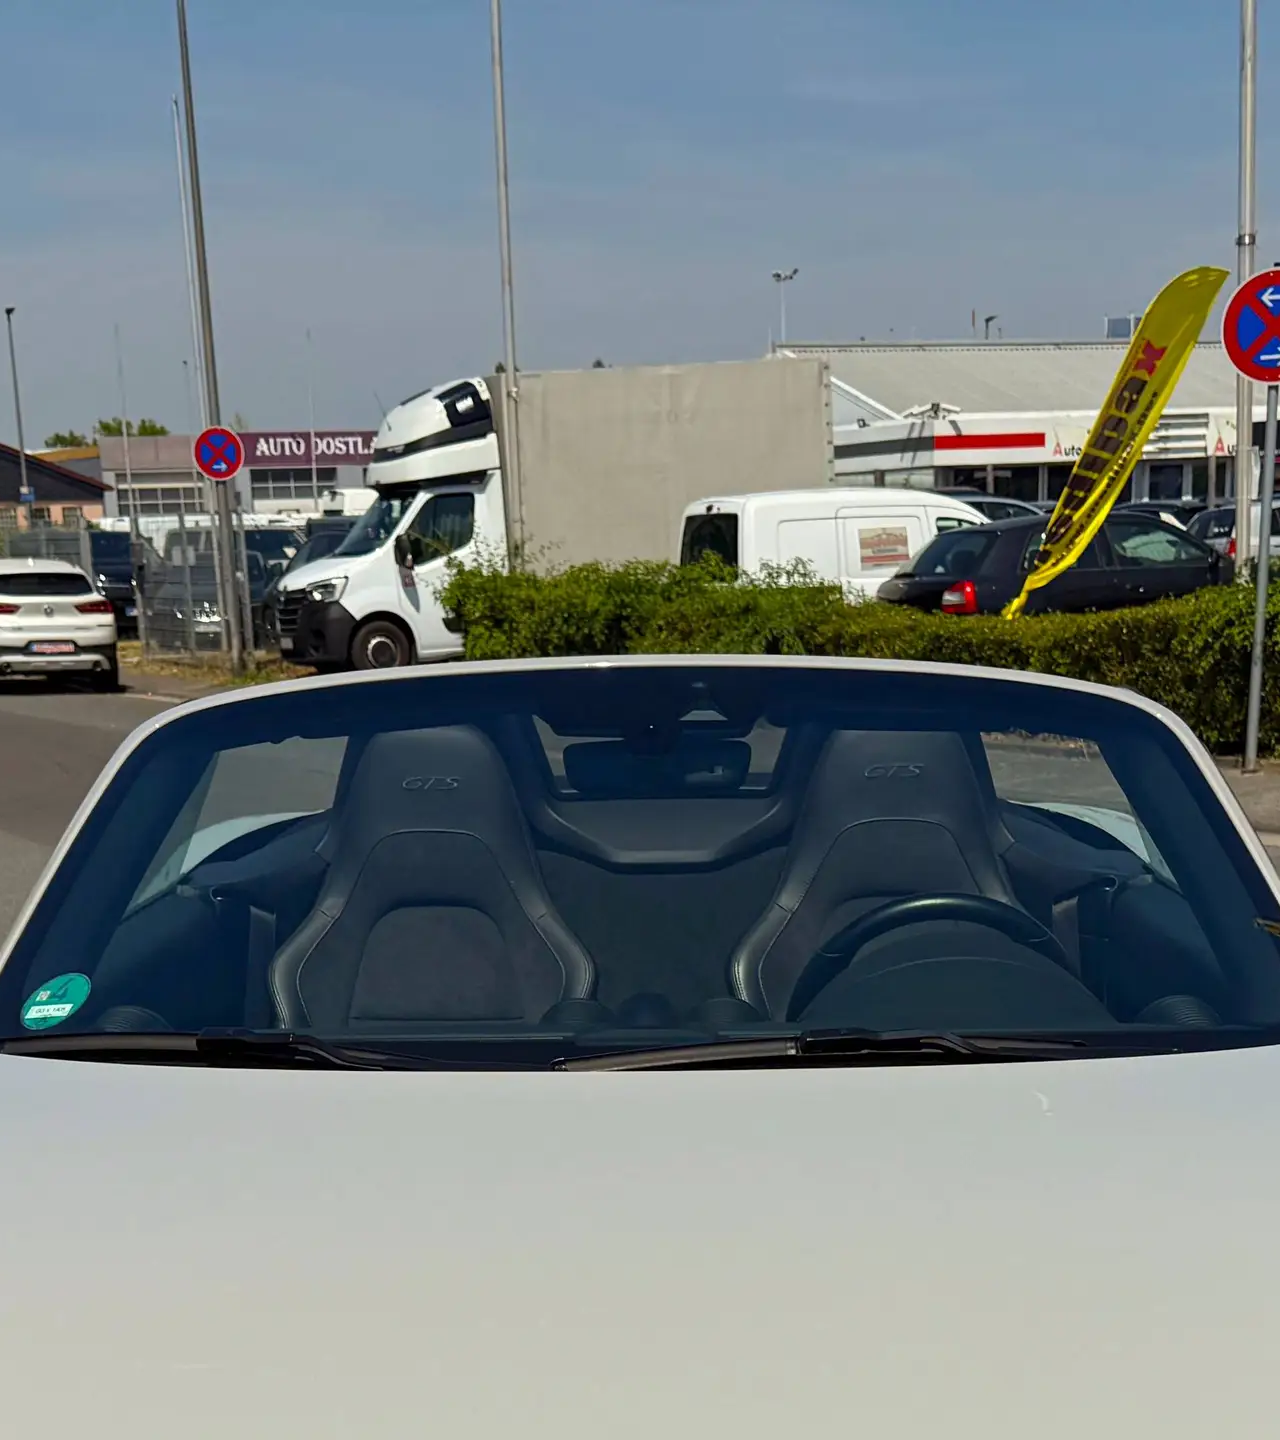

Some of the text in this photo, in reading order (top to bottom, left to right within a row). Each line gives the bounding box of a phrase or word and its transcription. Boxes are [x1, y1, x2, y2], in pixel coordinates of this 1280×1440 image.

[255, 437, 306, 456] AUTO
[863, 762, 925, 779] GTS
[402, 775, 463, 791] GTS
